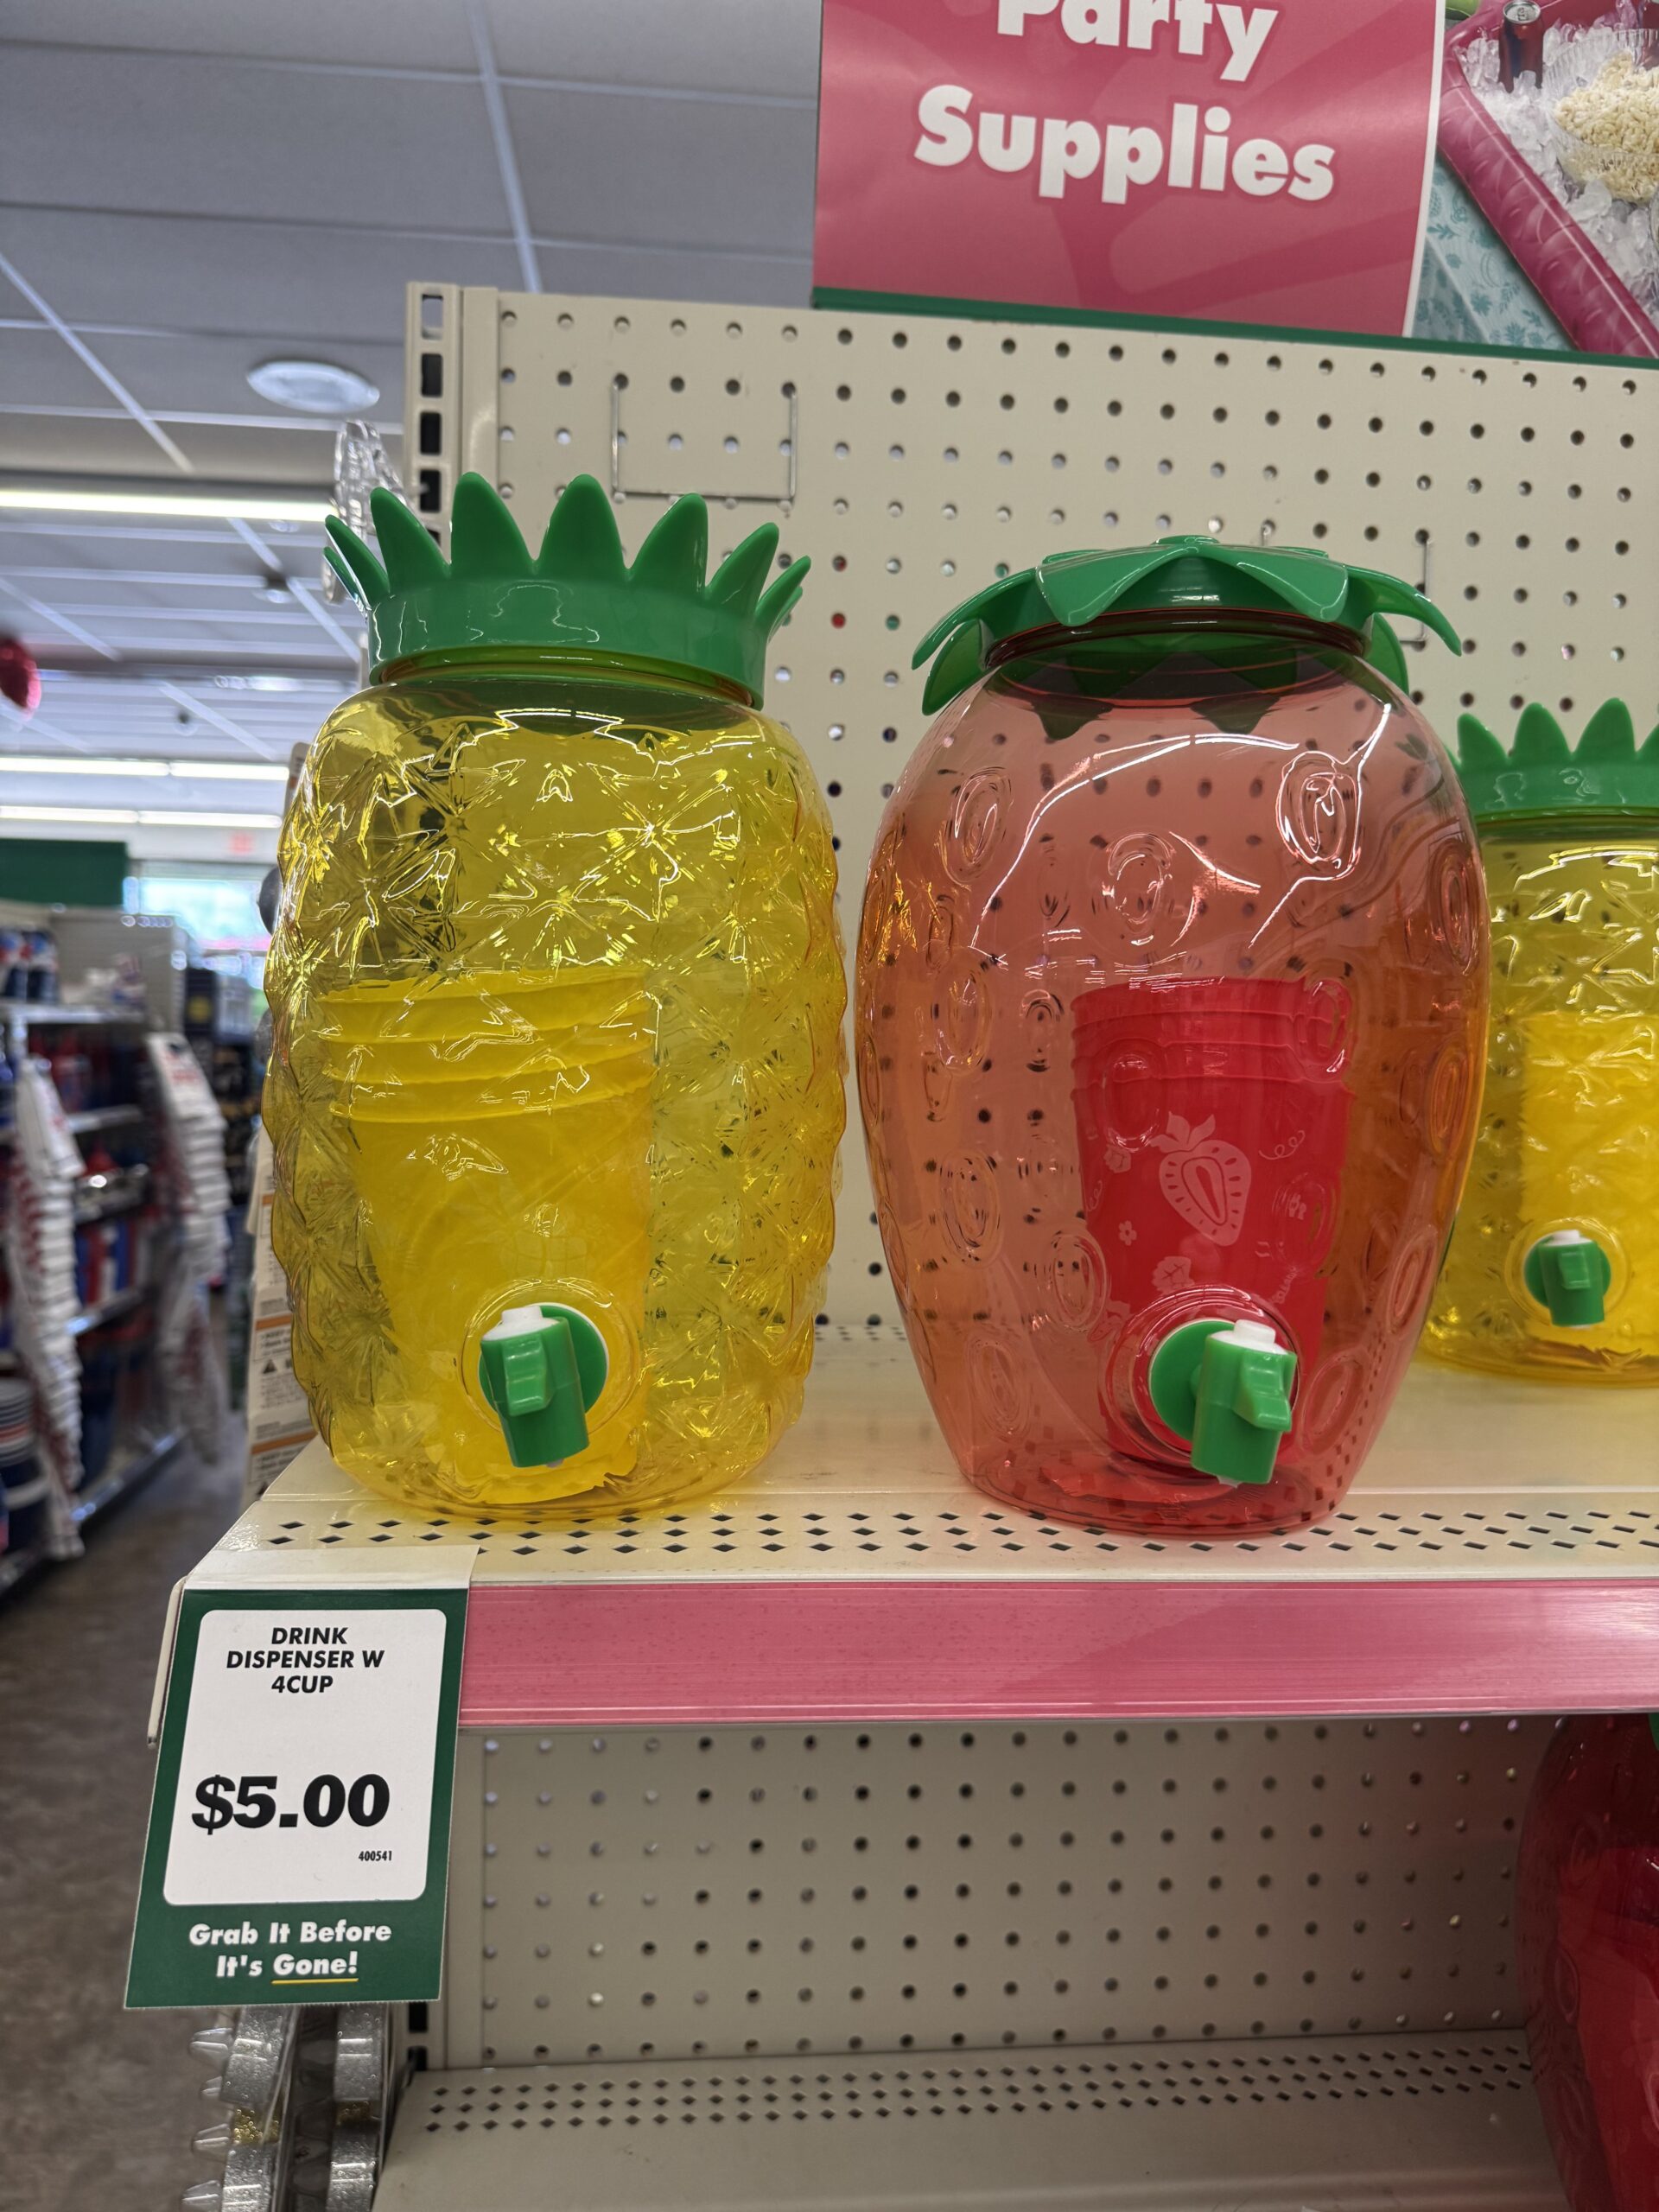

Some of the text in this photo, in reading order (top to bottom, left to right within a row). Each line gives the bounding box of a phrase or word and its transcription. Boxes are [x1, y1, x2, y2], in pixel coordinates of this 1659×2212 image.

[914, 84, 1335, 204] Supplies
[271, 1627, 348, 1645] DRINK
[226, 1649, 385, 1669] DISPENSER W
[270, 1675, 334, 1694] 4CUP
[191, 1773, 391, 1836] $5.00
[358, 1850, 392, 1862] 400541
[188, 1918, 392, 1946] Grab It Before
[216, 1950, 359, 1978] It's Gone!
